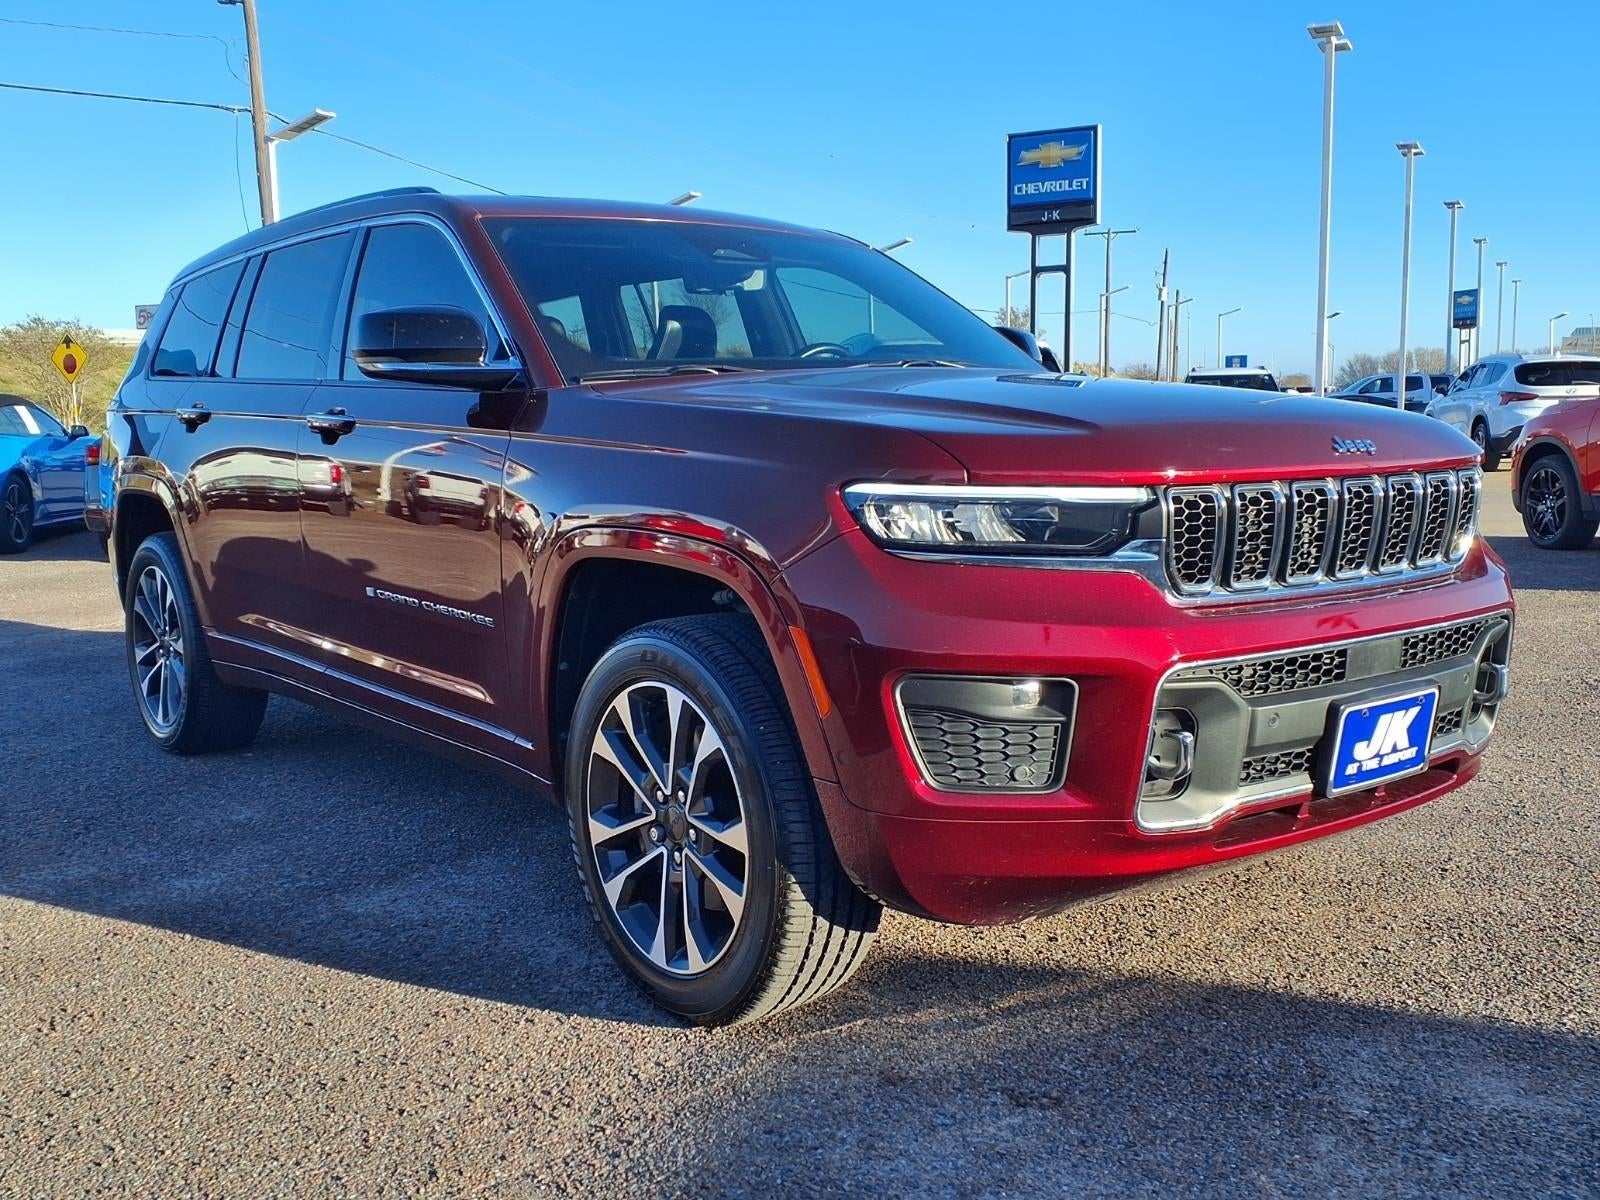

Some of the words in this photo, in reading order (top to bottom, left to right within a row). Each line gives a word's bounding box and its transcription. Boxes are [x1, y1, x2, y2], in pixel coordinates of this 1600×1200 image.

[1014, 178, 1089, 195] CHEVROLET
[1041, 209, 1060, 222] J-K
[1332, 435, 1377, 456] Jeep
[376, 589, 419, 607] GRAND
[421, 600, 496, 628] CHEROKEE
[1353, 706, 1421, 761] JK
